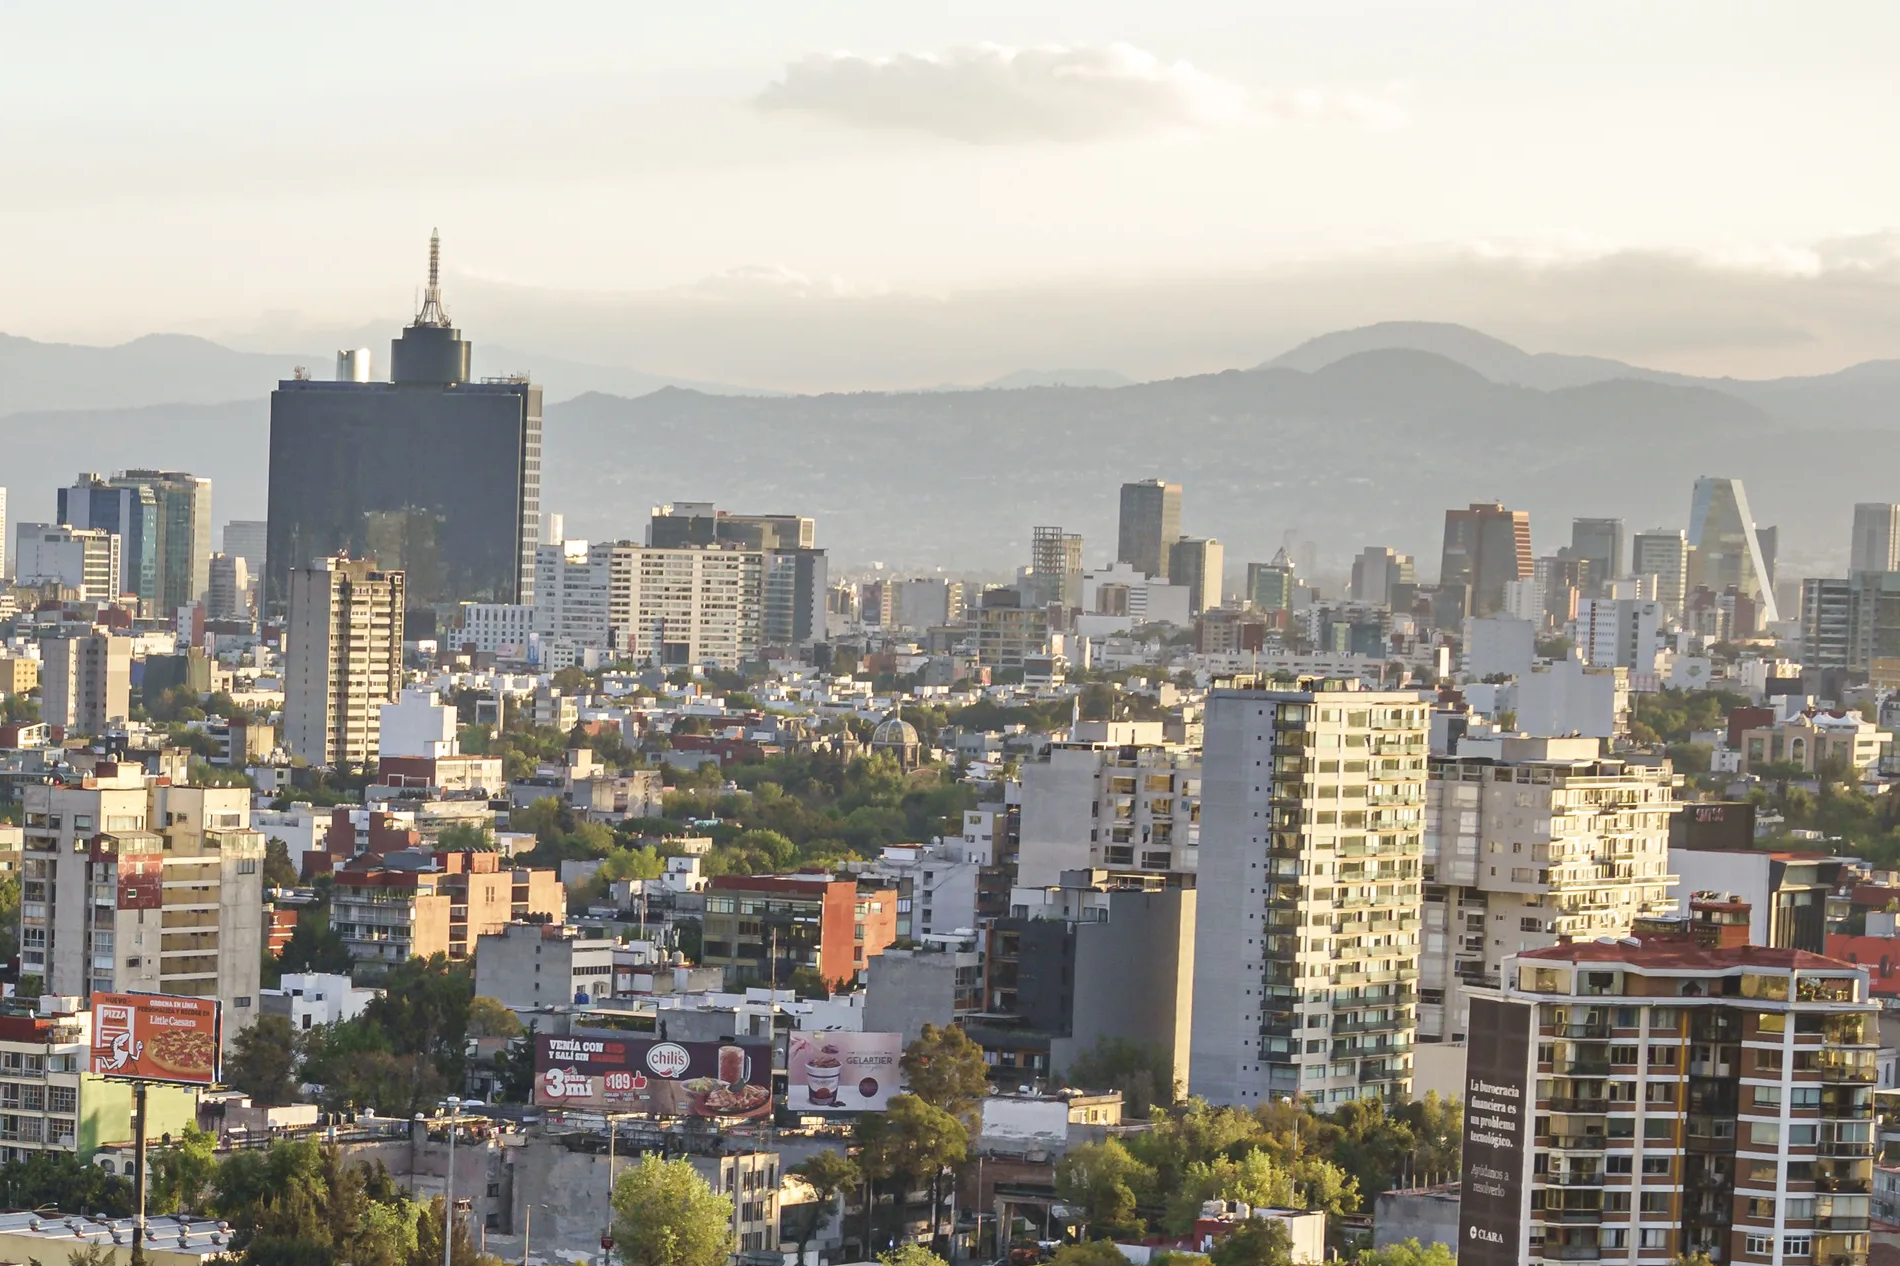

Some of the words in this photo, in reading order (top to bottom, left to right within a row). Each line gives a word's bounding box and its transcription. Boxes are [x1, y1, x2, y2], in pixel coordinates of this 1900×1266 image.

[150, 1000, 173, 1008] ORDENA
[104, 1009, 127, 1019] PIZZA
[150, 1015, 168, 1025] Little
[169, 1016, 196, 1027] Caesars
[550, 1039, 580, 1052] VENÍA
[583, 1042, 604, 1052] CON
[549, 1051, 554, 1059] Y
[555, 1050, 574, 1060] SALÍ
[575, 1053, 589, 1061] SIN
[651, 1050, 685, 1065] chili's
[847, 1056, 893, 1065] GELARTIER
[545, 1068, 566, 1097] 3
[564, 1074, 585, 1083] para
[606, 1073, 631, 1089] $189
[565, 1079, 593, 1097] mí
[1471, 1079, 1479, 1091] La
[1480, 1080, 1519, 1097] burocracia
[1472, 1095, 1506, 1112] financiera
[1507, 1105, 1517, 1114] es
[1471, 1115, 1479, 1125] un
[1480, 1115, 1515, 1131] problema
[1470, 1130, 1513, 1148] tecnológico.
[1471, 1164, 1503, 1180] Ayúdanos
[1473, 1182, 1505, 1197] resolverlo
[1478, 1228, 1504, 1244] CLARA
